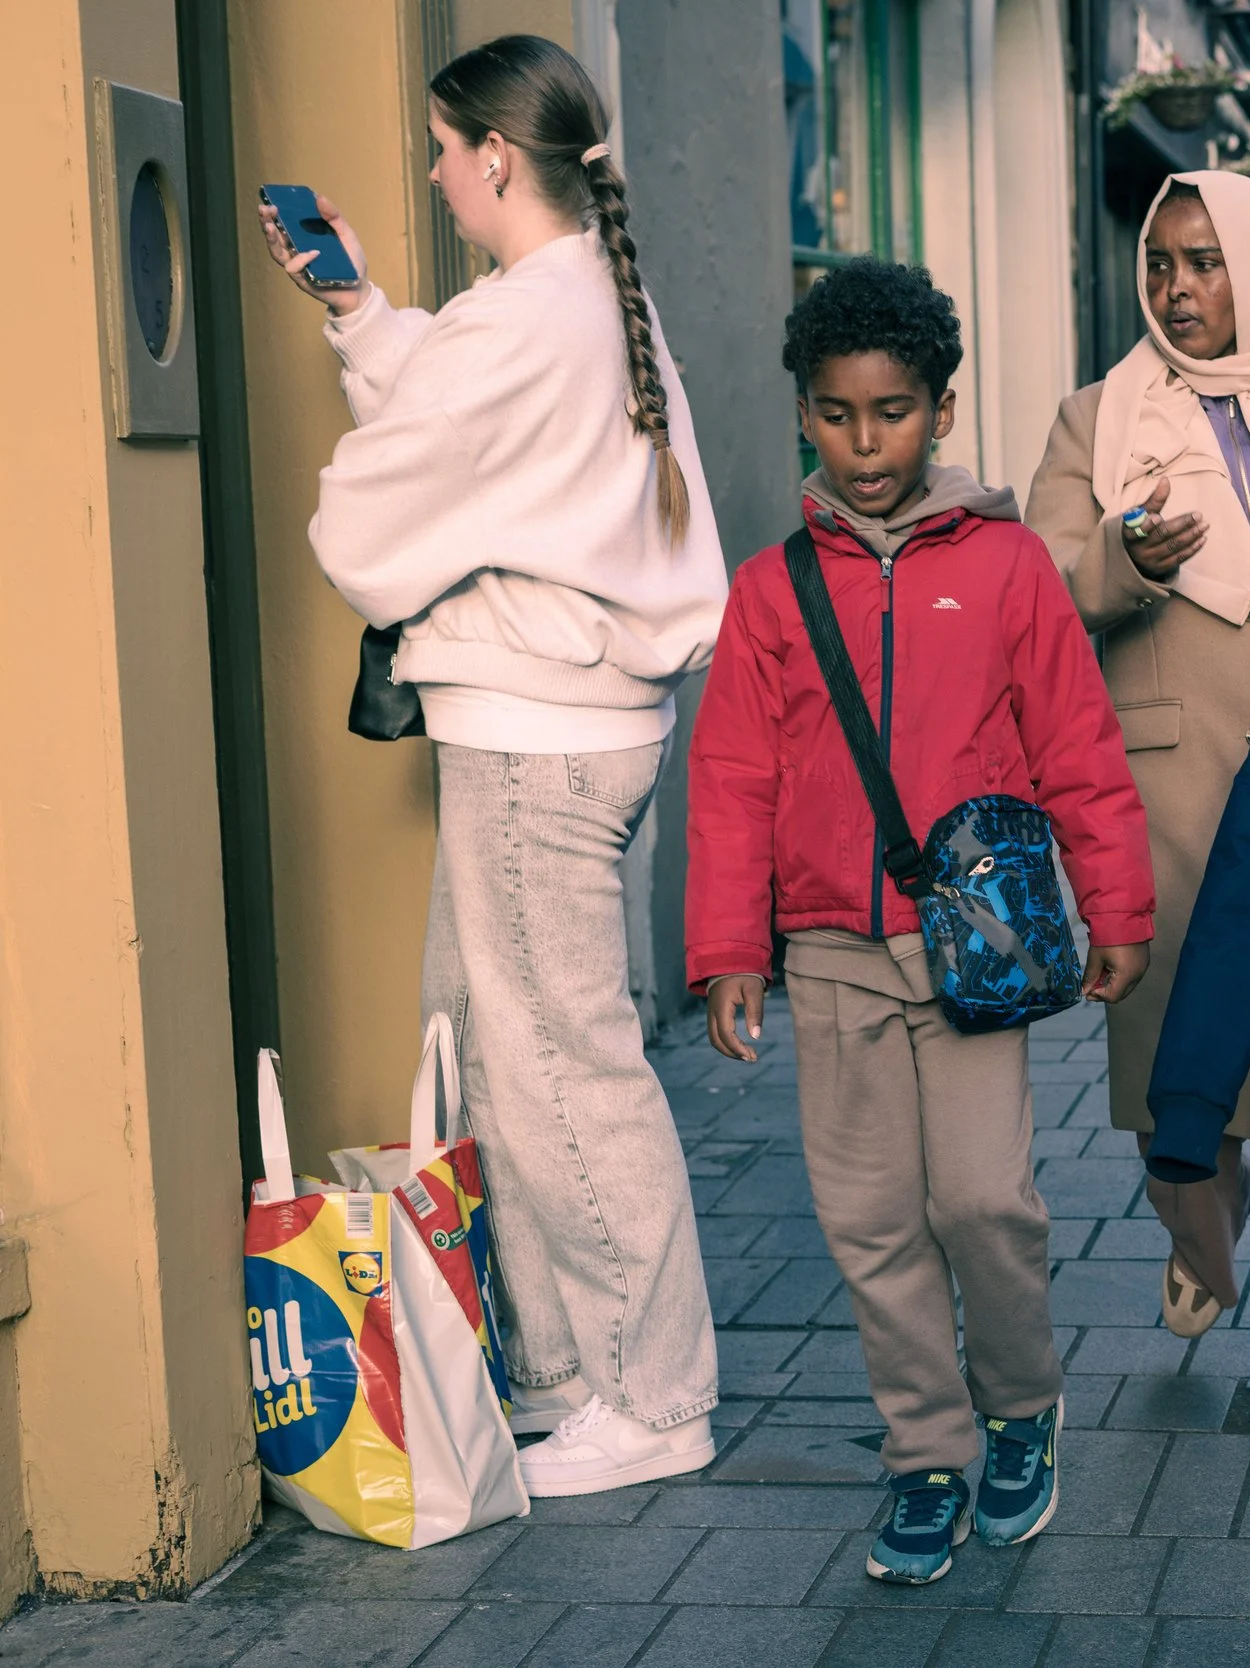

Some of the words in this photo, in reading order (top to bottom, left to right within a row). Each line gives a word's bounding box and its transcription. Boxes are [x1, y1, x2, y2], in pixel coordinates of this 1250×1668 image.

[253, 1377, 318, 1434] Lidl
[986, 1418, 1007, 1432] NIKE
[927, 1473, 951, 1485] NIKE
